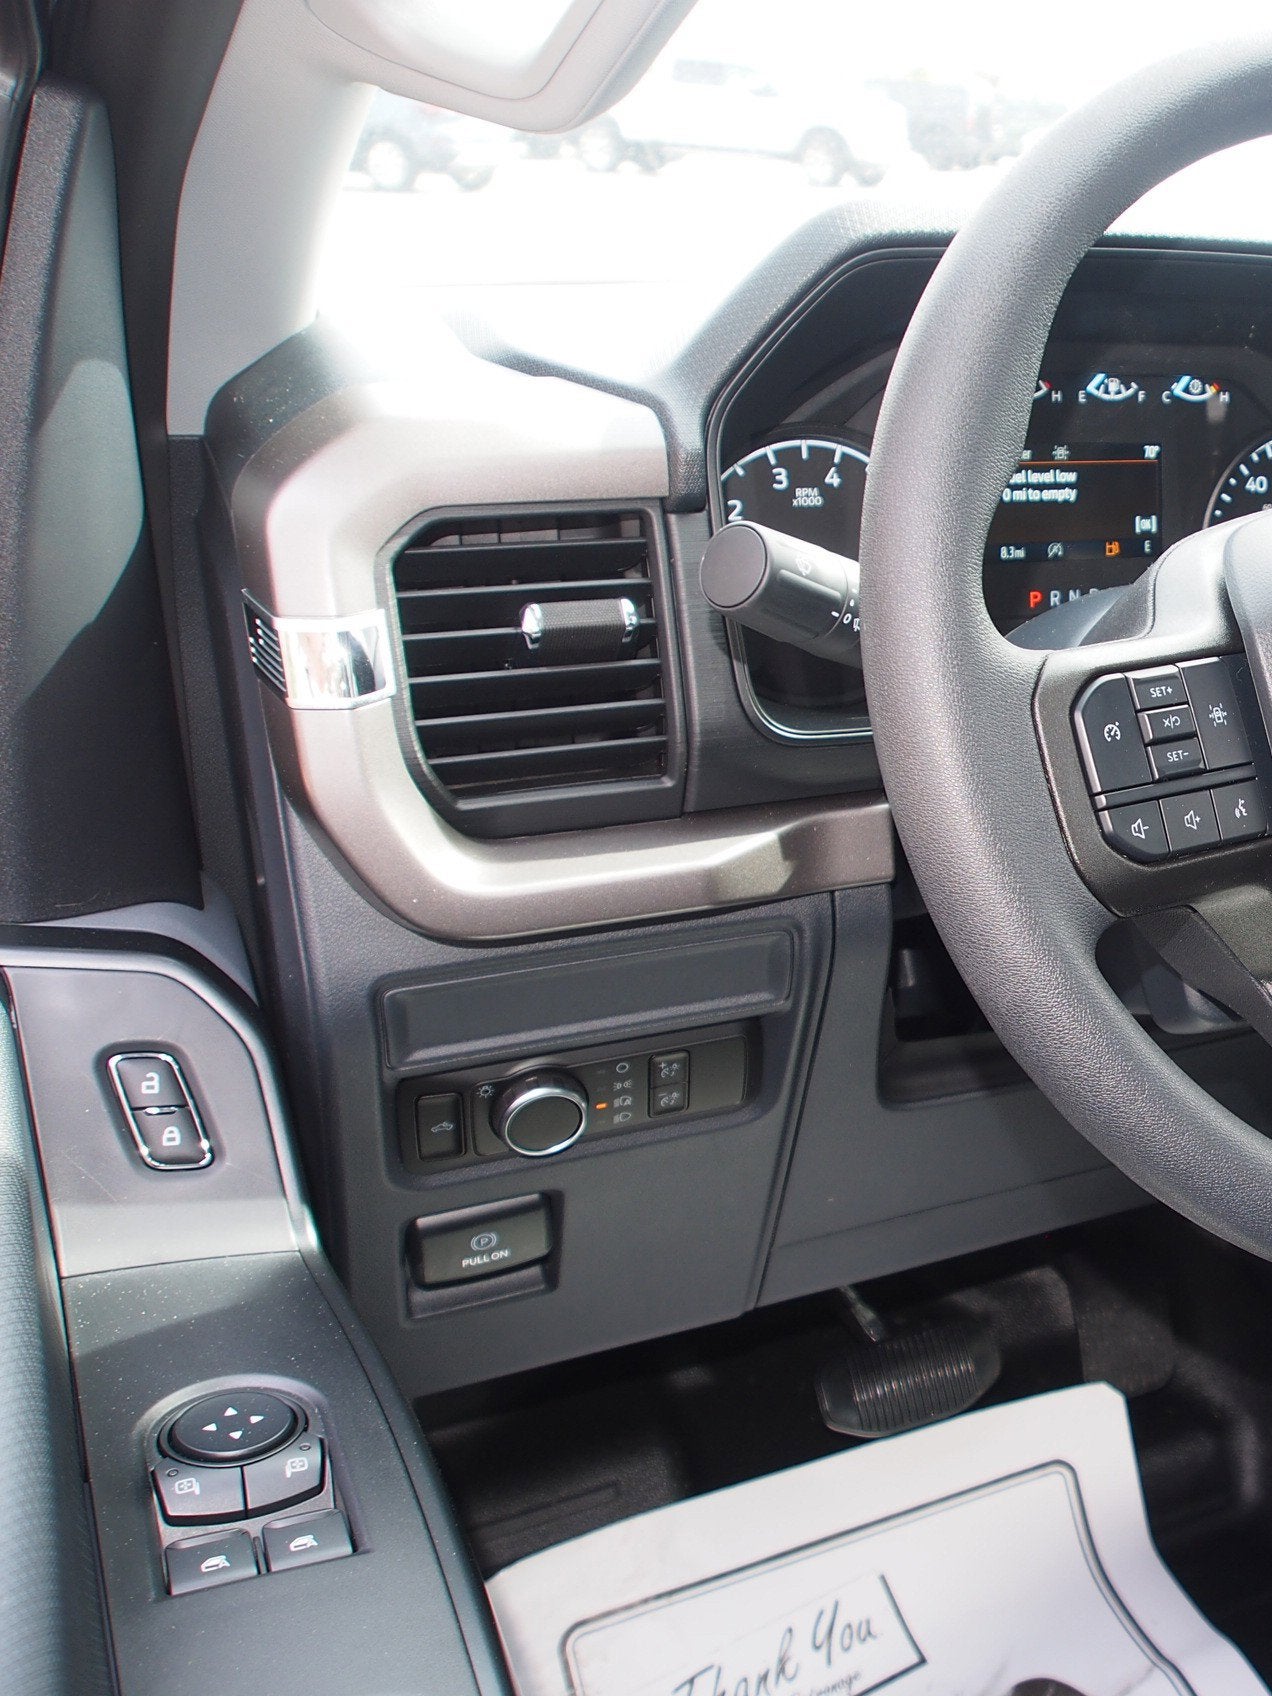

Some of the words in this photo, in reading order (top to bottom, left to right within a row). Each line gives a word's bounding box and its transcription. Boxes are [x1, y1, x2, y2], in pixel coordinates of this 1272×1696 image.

[1052, 391, 1062, 402] H
[1078, 391, 1087, 402] E
[1138, 391, 1147, 402] F
[1162, 391, 1172, 402] C
[1219, 391, 1230, 402] H
[772, 467, 789, 490] 3
[824, 467, 842, 488] 4
[1009, 469, 1027, 484] uel
[1027, 469, 1055, 484] level
[1056, 469, 1078, 484] low
[1245, 475, 1269, 493] 40
[795, 487, 820, 498] RPM
[1012, 487, 1027, 502] mi
[1028, 488, 1041, 502] to
[1041, 487, 1078, 503] empty
[792, 496, 824, 507] x1000
[727, 500, 744, 521] 2
[1029, 590, 1043, 608] P
[1050, 590, 1061, 607] R
[462, 1254, 489, 1268] PULL
[491, 1249, 509, 1261] ON
[672, 1626, 800, 1696] Thank
[811, 1599, 877, 1667] You
